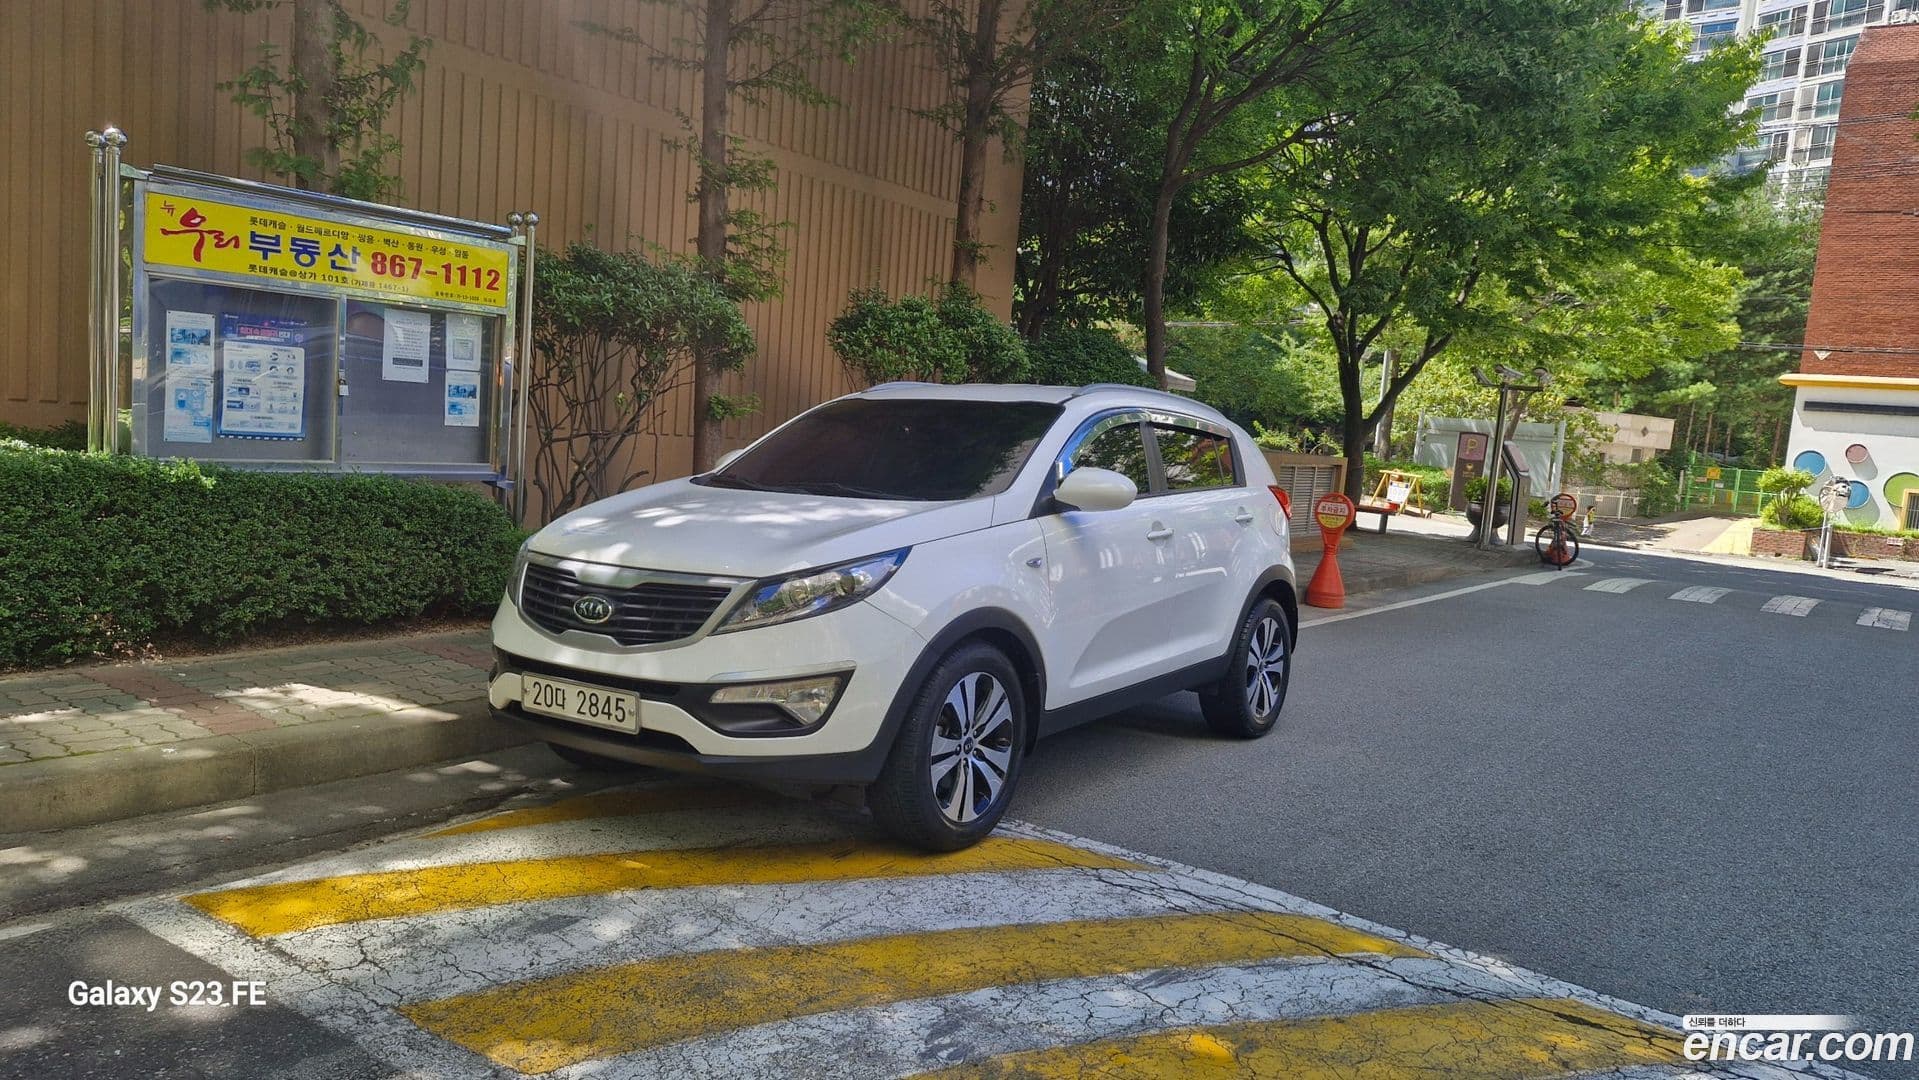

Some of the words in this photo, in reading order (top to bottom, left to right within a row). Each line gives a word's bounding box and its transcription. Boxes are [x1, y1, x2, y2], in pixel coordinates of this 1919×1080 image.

[160, 200, 176, 216] 뉴
[249, 216, 287, 231] 롯데캐슬
[297, 223, 349, 240] 월드메르디앙
[431, 245, 447, 256] 우성
[160, 207, 240, 262] 우리
[248, 230, 361, 273] 부동산
[371, 251, 500, 291] 867-1112
[321, 273, 348, 284] 101호
[1465, 439, 1478, 455] P
[580, 602, 603, 617] KIA
[577, 690, 625, 723] 2845
